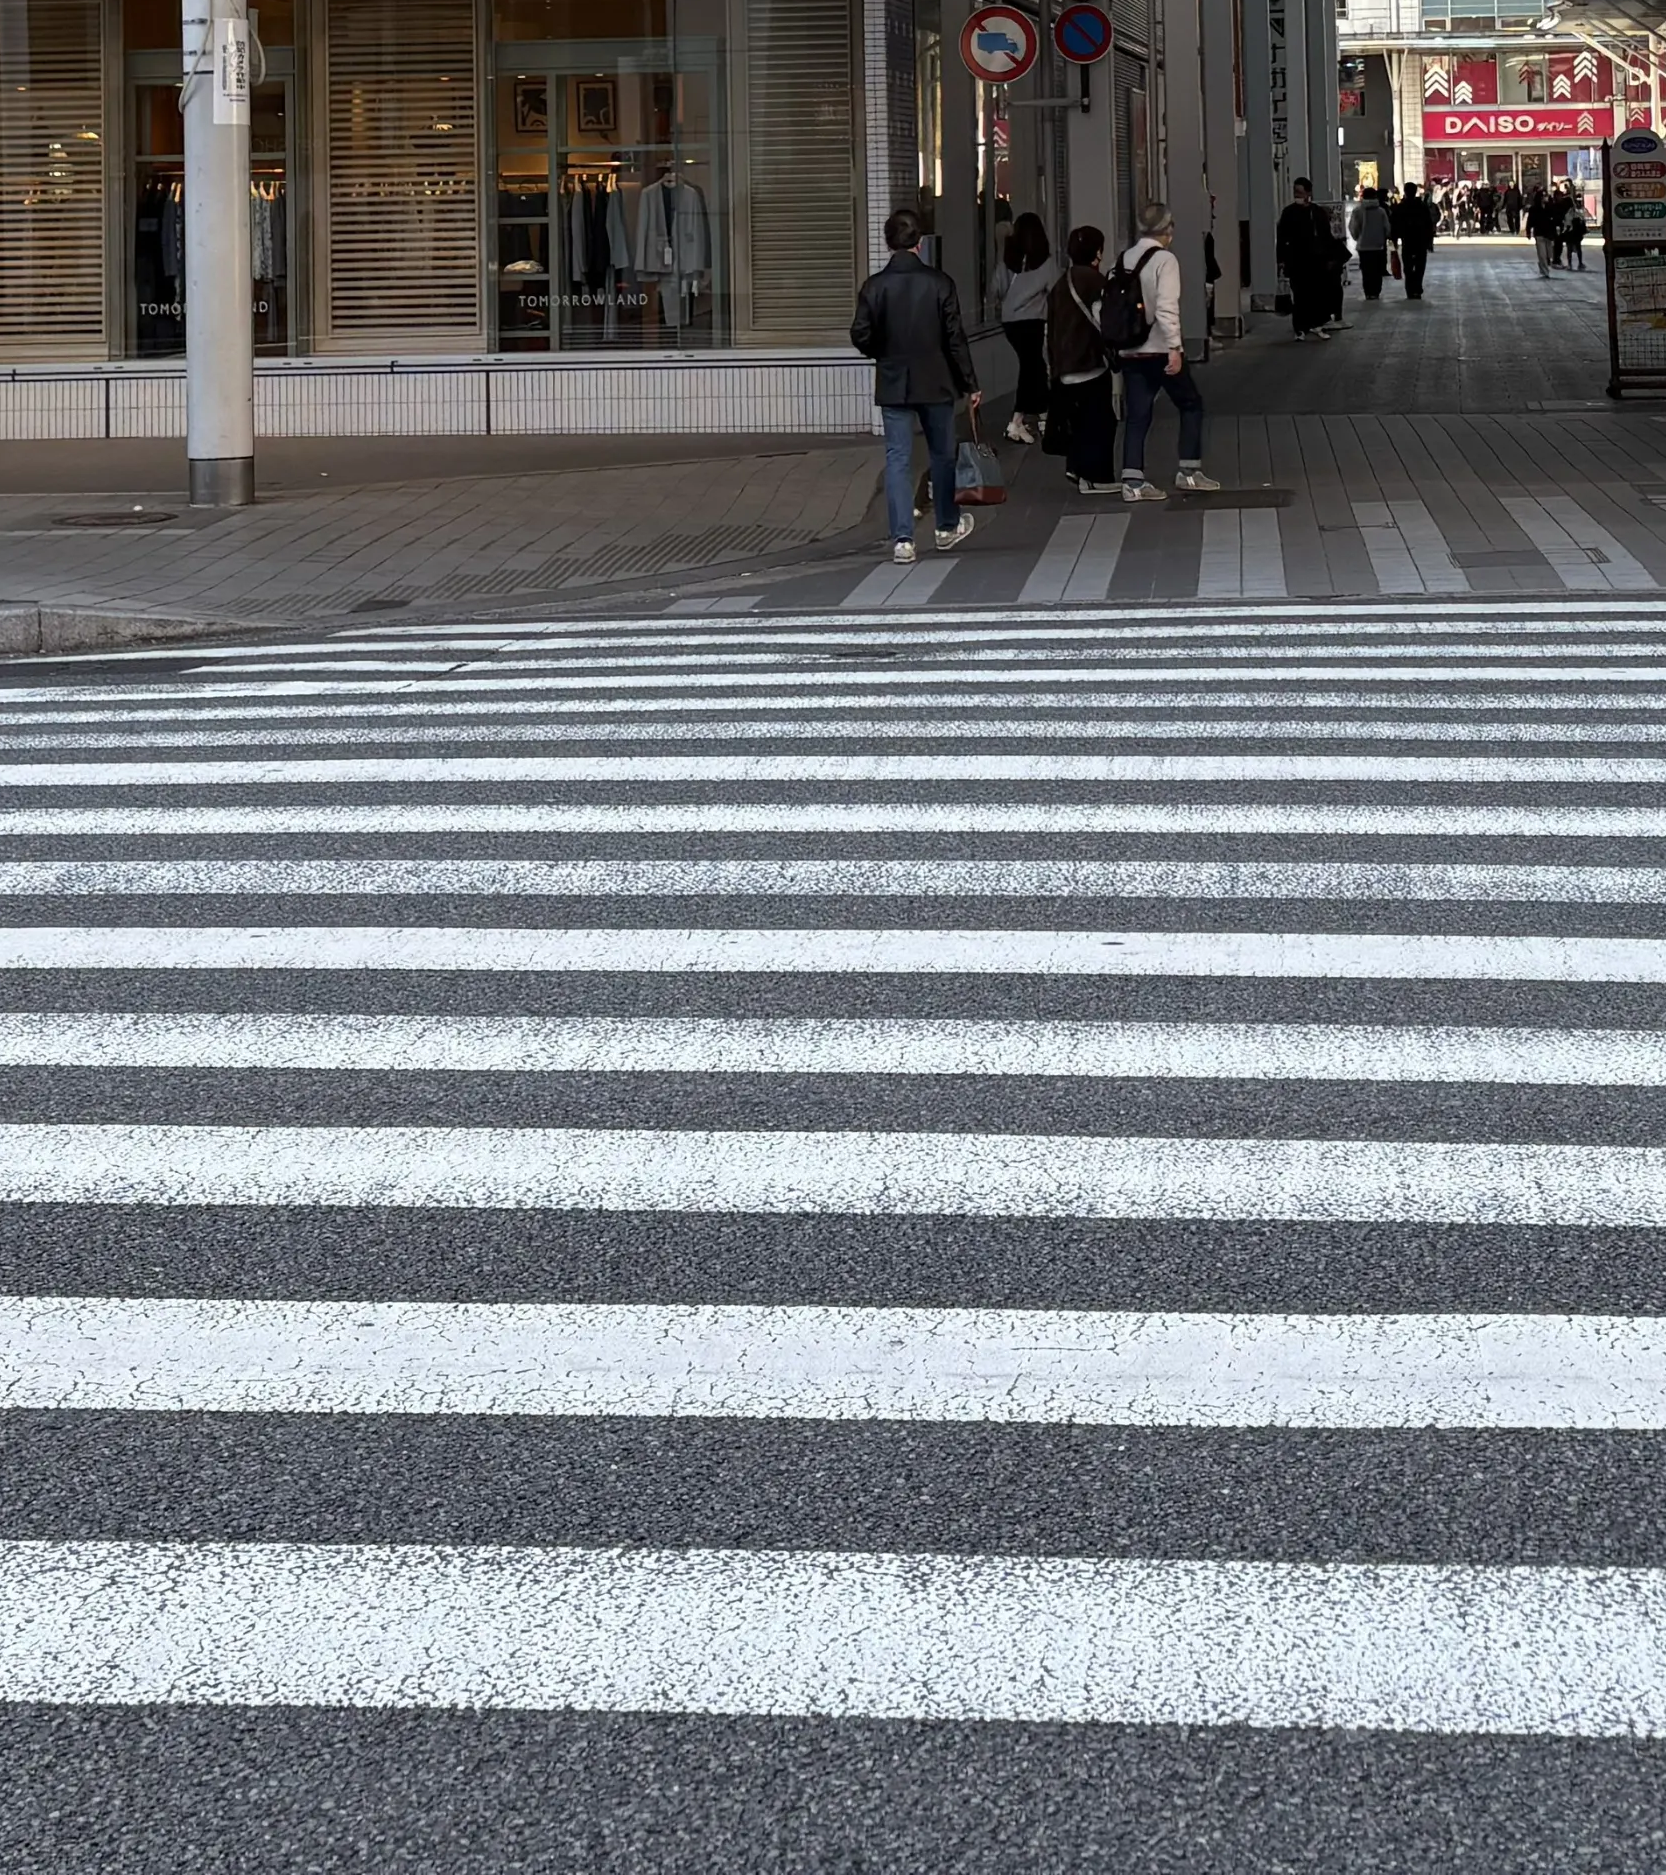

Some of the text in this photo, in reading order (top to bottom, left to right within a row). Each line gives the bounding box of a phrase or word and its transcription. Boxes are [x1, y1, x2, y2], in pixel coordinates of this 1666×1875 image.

[1445, 115, 1573, 134] DAISO ダイソー
[519, 293, 649, 308] TOMORROWLAND
